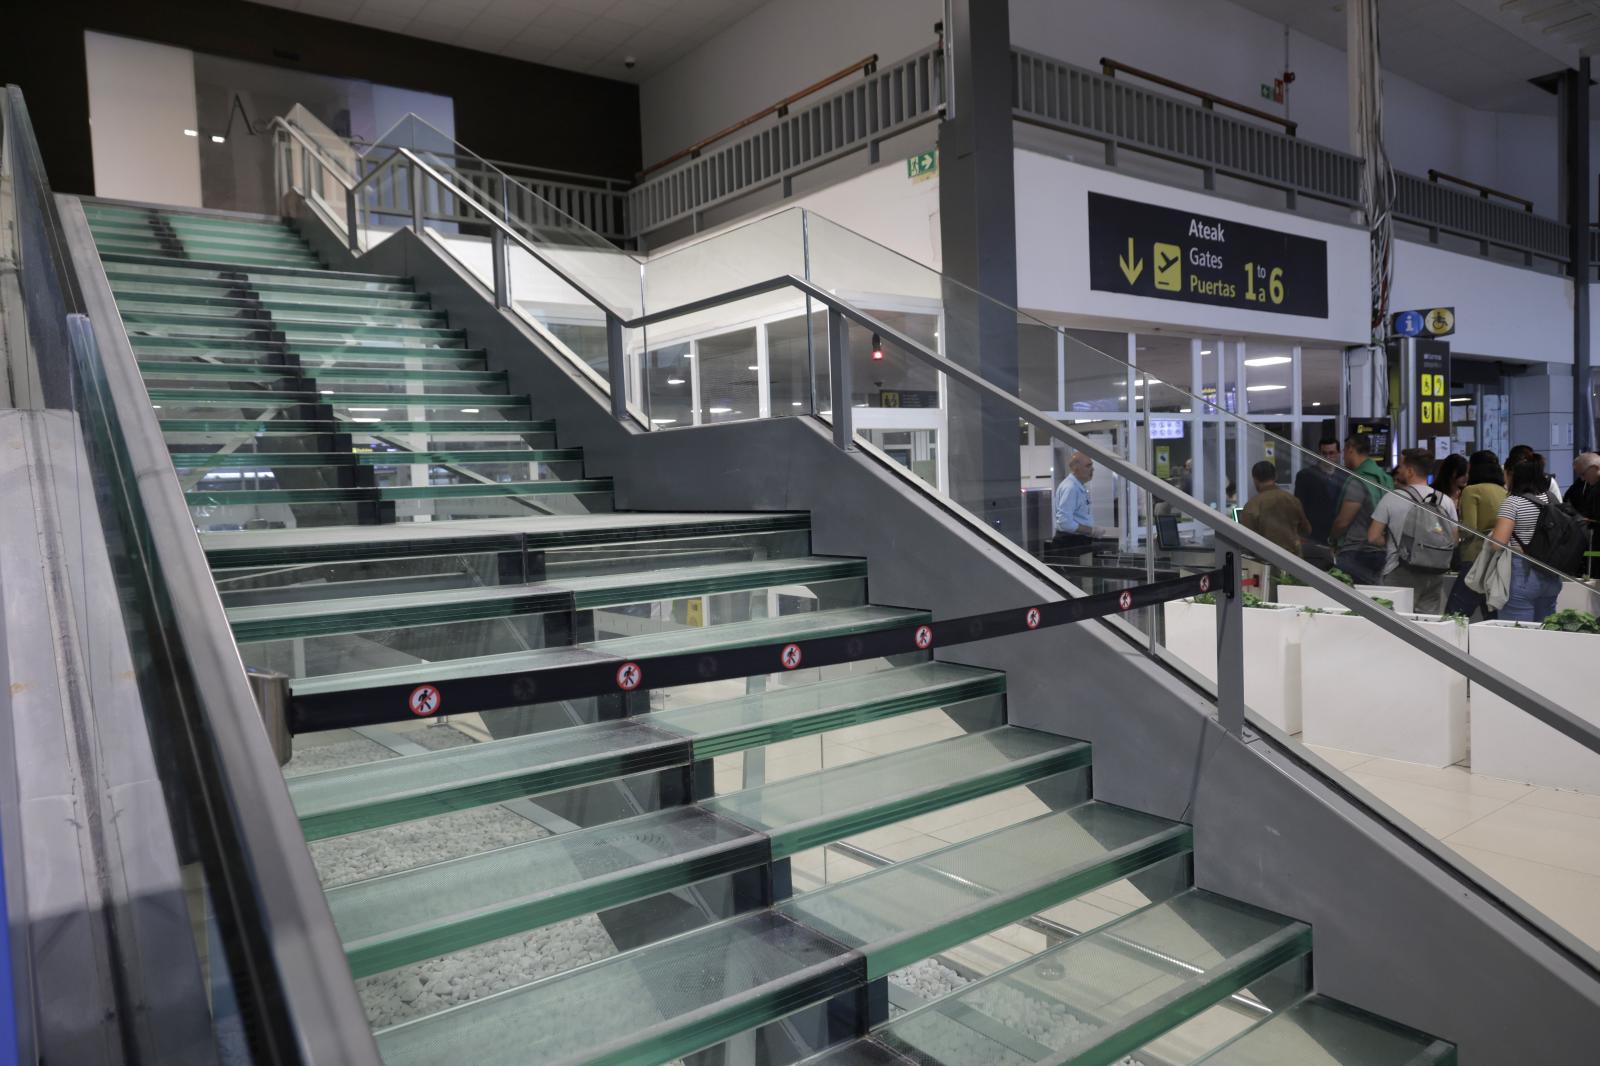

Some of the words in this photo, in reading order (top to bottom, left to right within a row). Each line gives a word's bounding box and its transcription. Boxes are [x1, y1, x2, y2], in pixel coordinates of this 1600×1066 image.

[1188, 219, 1225, 242] Ateak
[1189, 247, 1223, 269] Gates
[1257, 264, 1266, 279] to
[1190, 274, 1236, 298] Puertas
[1244, 262, 1256, 301] 1
[1258, 287, 1266, 302] a
[1269, 266, 1284, 305] 6
